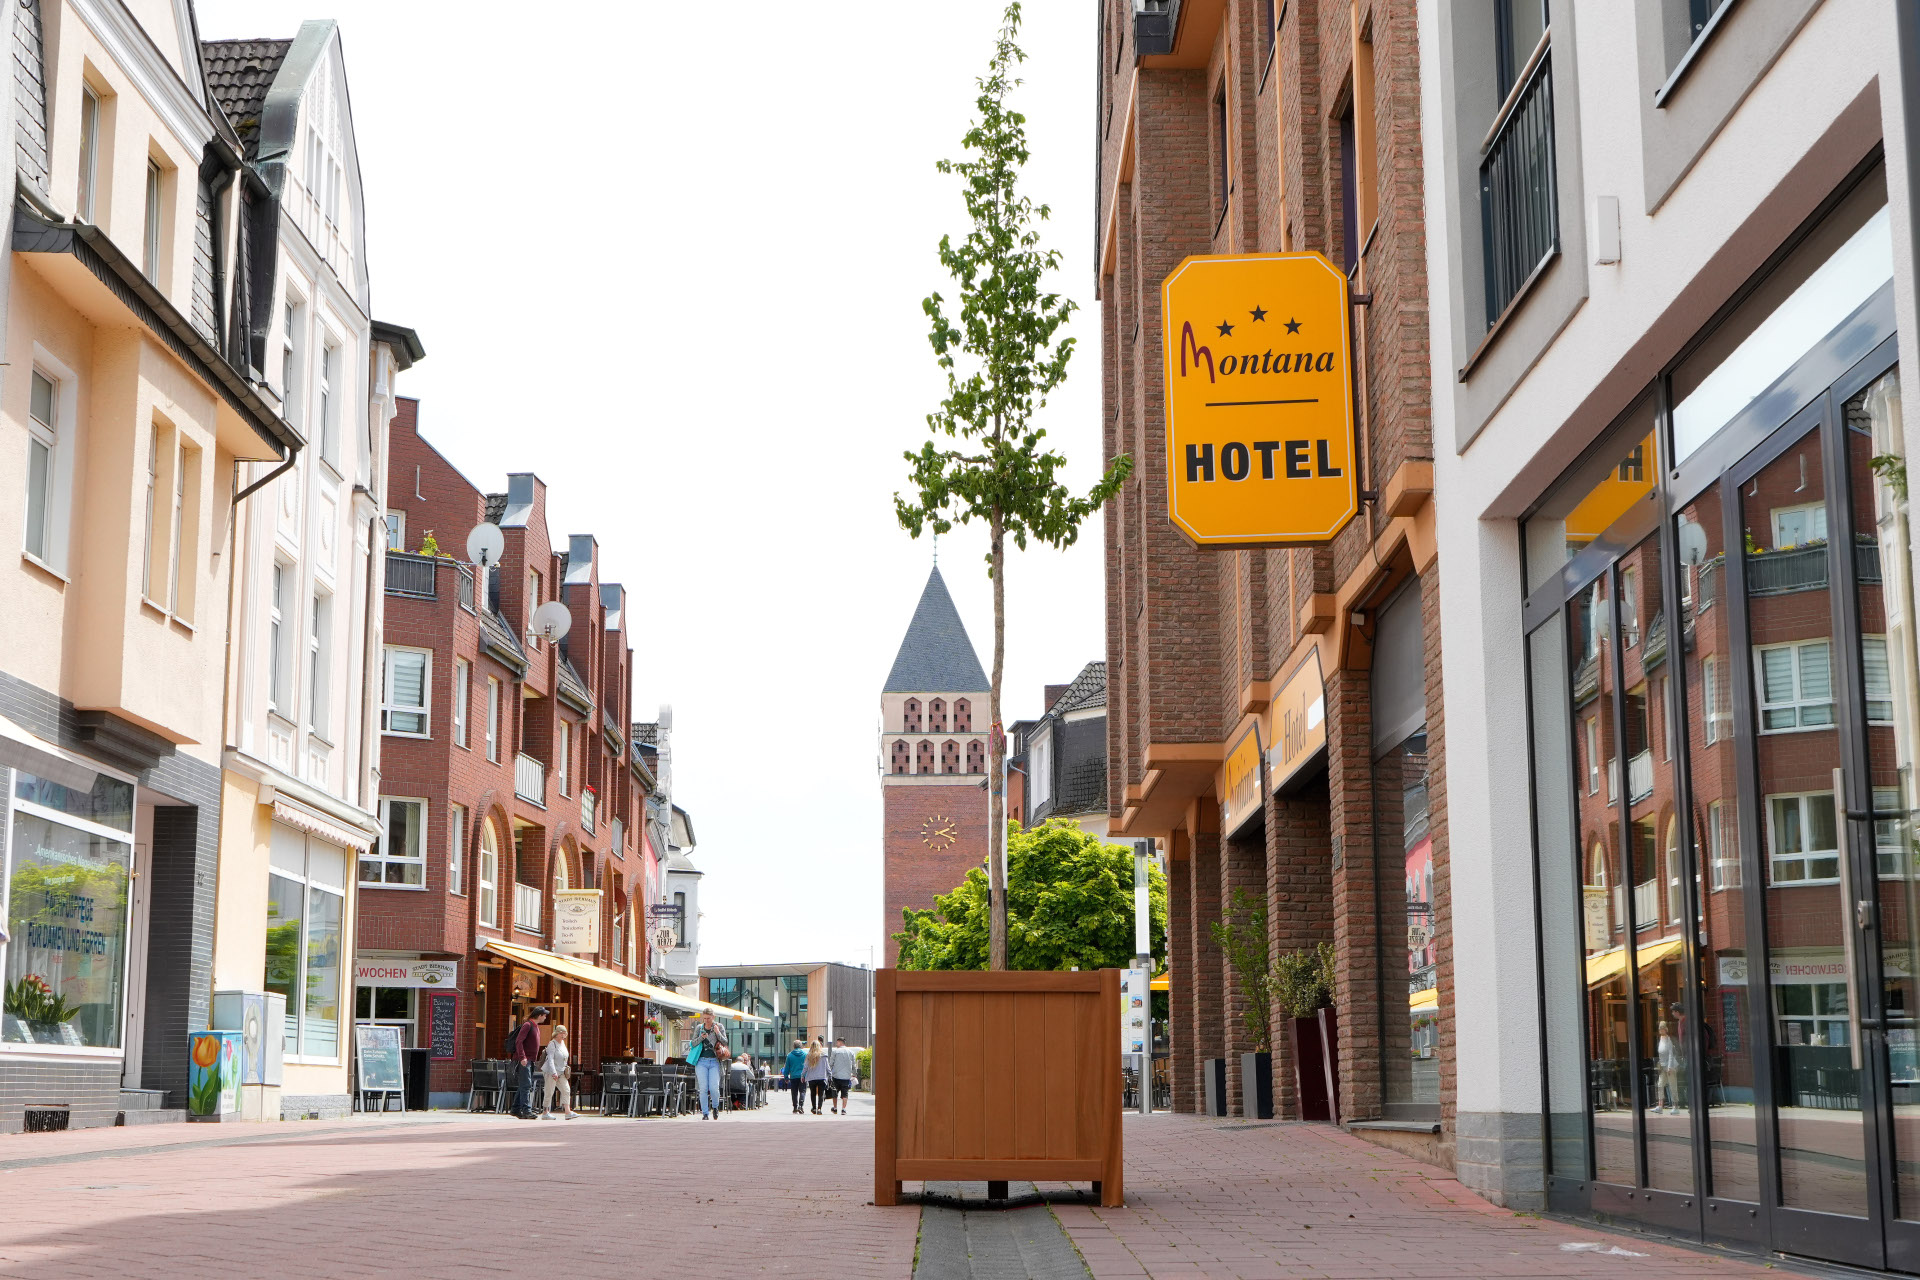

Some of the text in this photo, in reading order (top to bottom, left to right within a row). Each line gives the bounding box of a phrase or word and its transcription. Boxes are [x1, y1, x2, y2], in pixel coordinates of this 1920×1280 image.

[1180, 319, 1336, 385] Montana
[1185, 438, 1344, 484] HOTEL
[1284, 690, 1307, 767] Hotel
[43, 924, 65, 951] DAMEN
[67, 926, 81, 952] UND
[83, 928, 106, 956] HERREN
[660, 930, 670, 938] ZUR
[357, 967, 407, 979] WOCHEN
[429, 963, 454, 972] BIERHAUS
